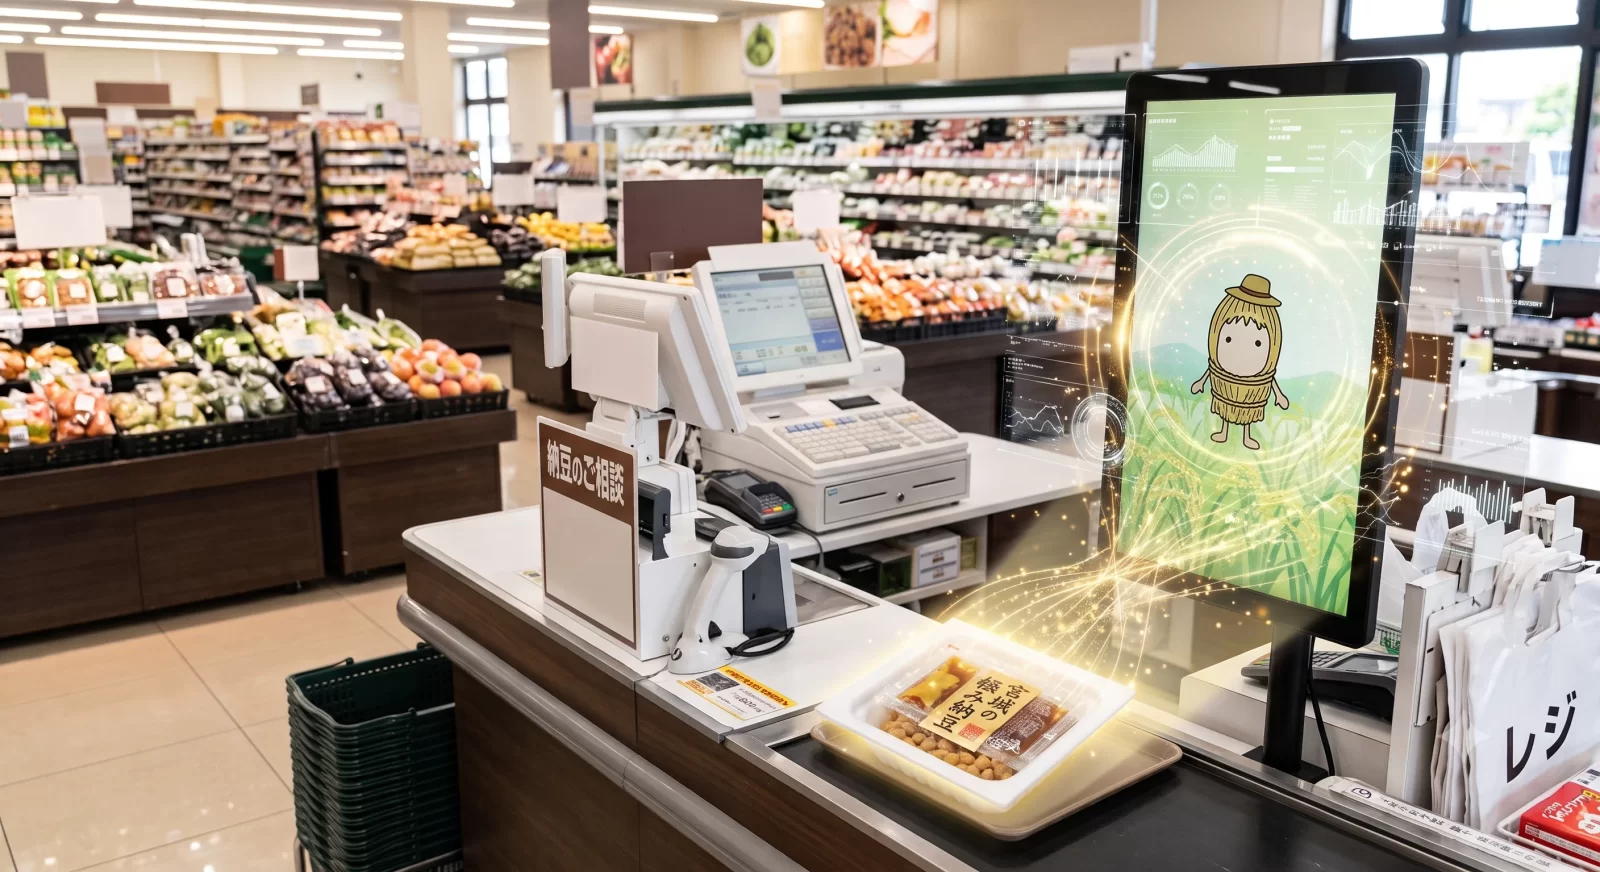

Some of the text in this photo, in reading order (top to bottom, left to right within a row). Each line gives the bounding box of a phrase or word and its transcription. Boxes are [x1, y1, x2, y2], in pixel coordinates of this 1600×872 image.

[547, 439, 624, 506] 納豆のご相談
[980, 684, 1030, 720] 宮城の
[1506, 690, 1577, 783] レジ
